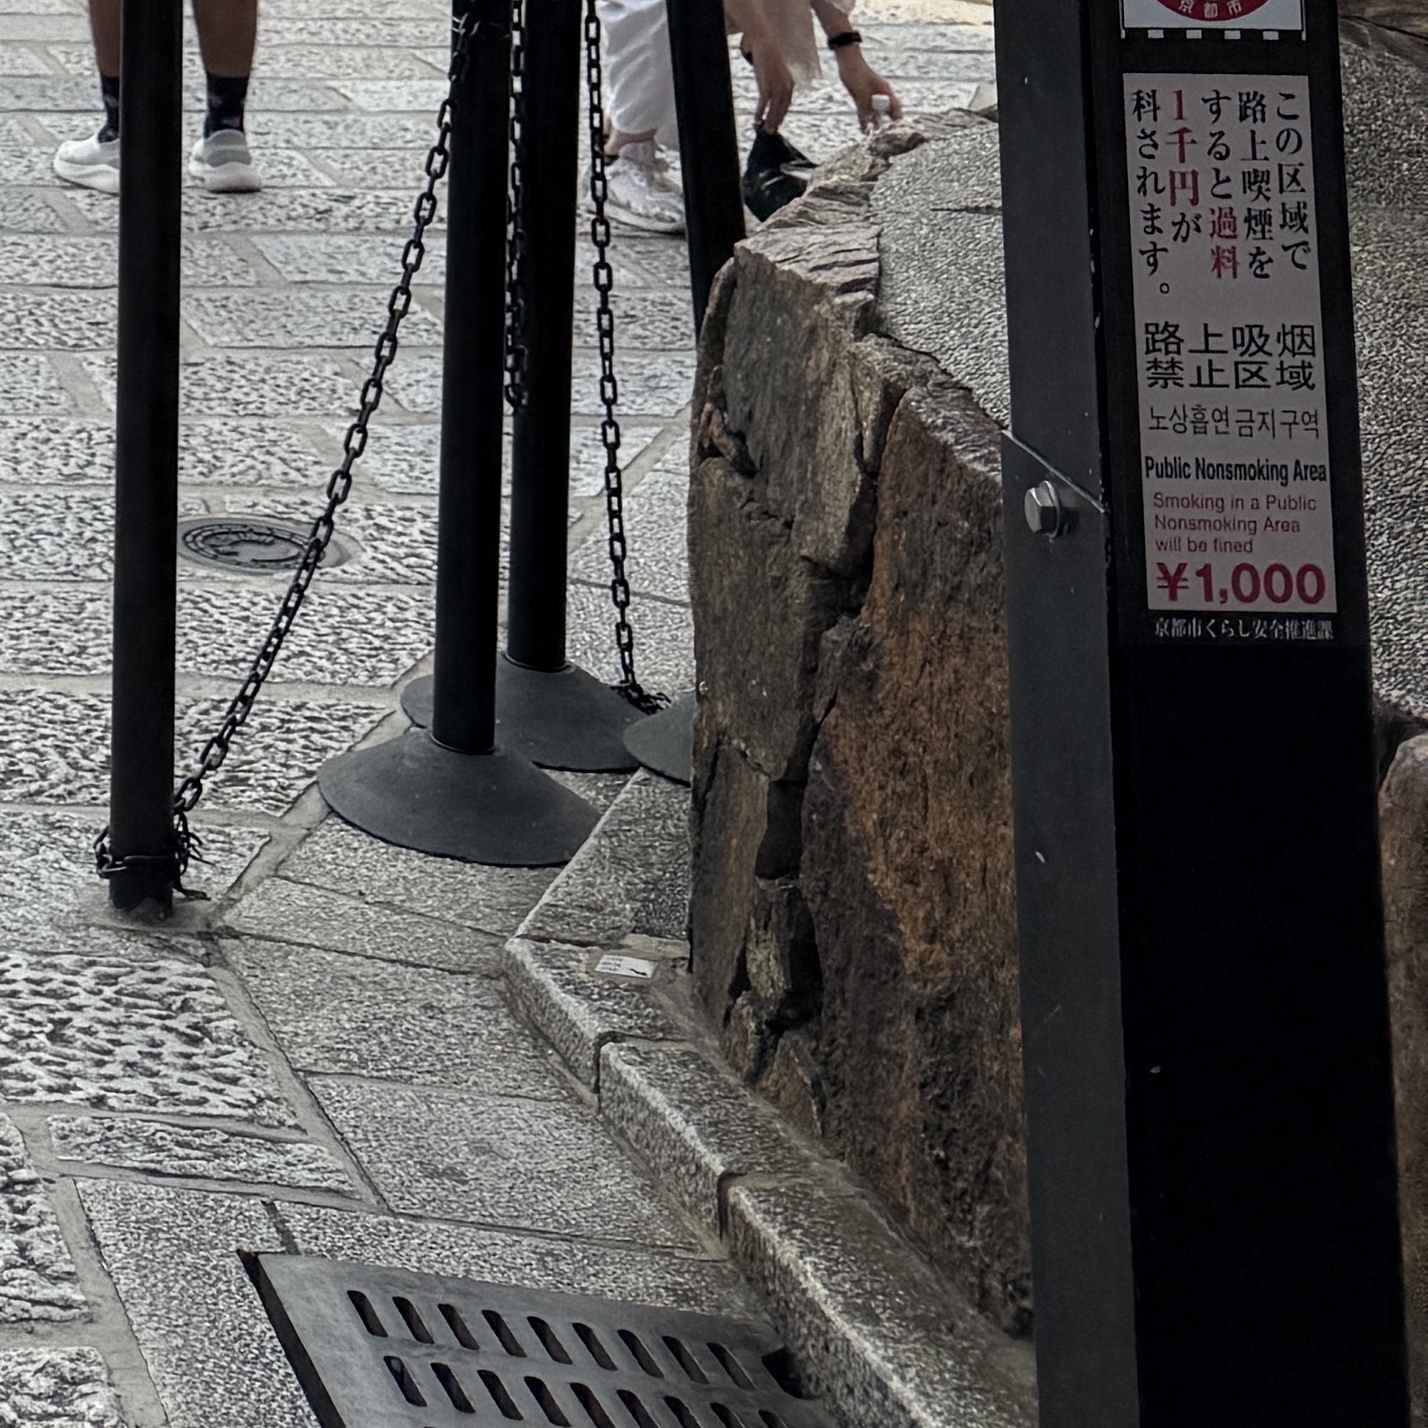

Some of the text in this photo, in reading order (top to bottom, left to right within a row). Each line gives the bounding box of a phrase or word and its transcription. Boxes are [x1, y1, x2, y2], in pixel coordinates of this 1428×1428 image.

[1132, 89, 1170, 294] 科されます。
[1201, 89, 1240, 279] すると過料
[1238, 91, 1274, 279] 路上喫煙を
[1275, 91, 1312, 270] この区域で
[1144, 321, 1316, 357] 路上吸烟
[1146, 357, 1316, 391] 禁止区域
[1145, 456, 1327, 487] Public Nonsmoking Area
[1153, 492, 1316, 513] Smoking in a Public
[1155, 515, 1300, 535] Nonsmoking Area
[1156, 537, 1253, 553] will be fined
[1156, 562, 1325, 604] ¥1,000
